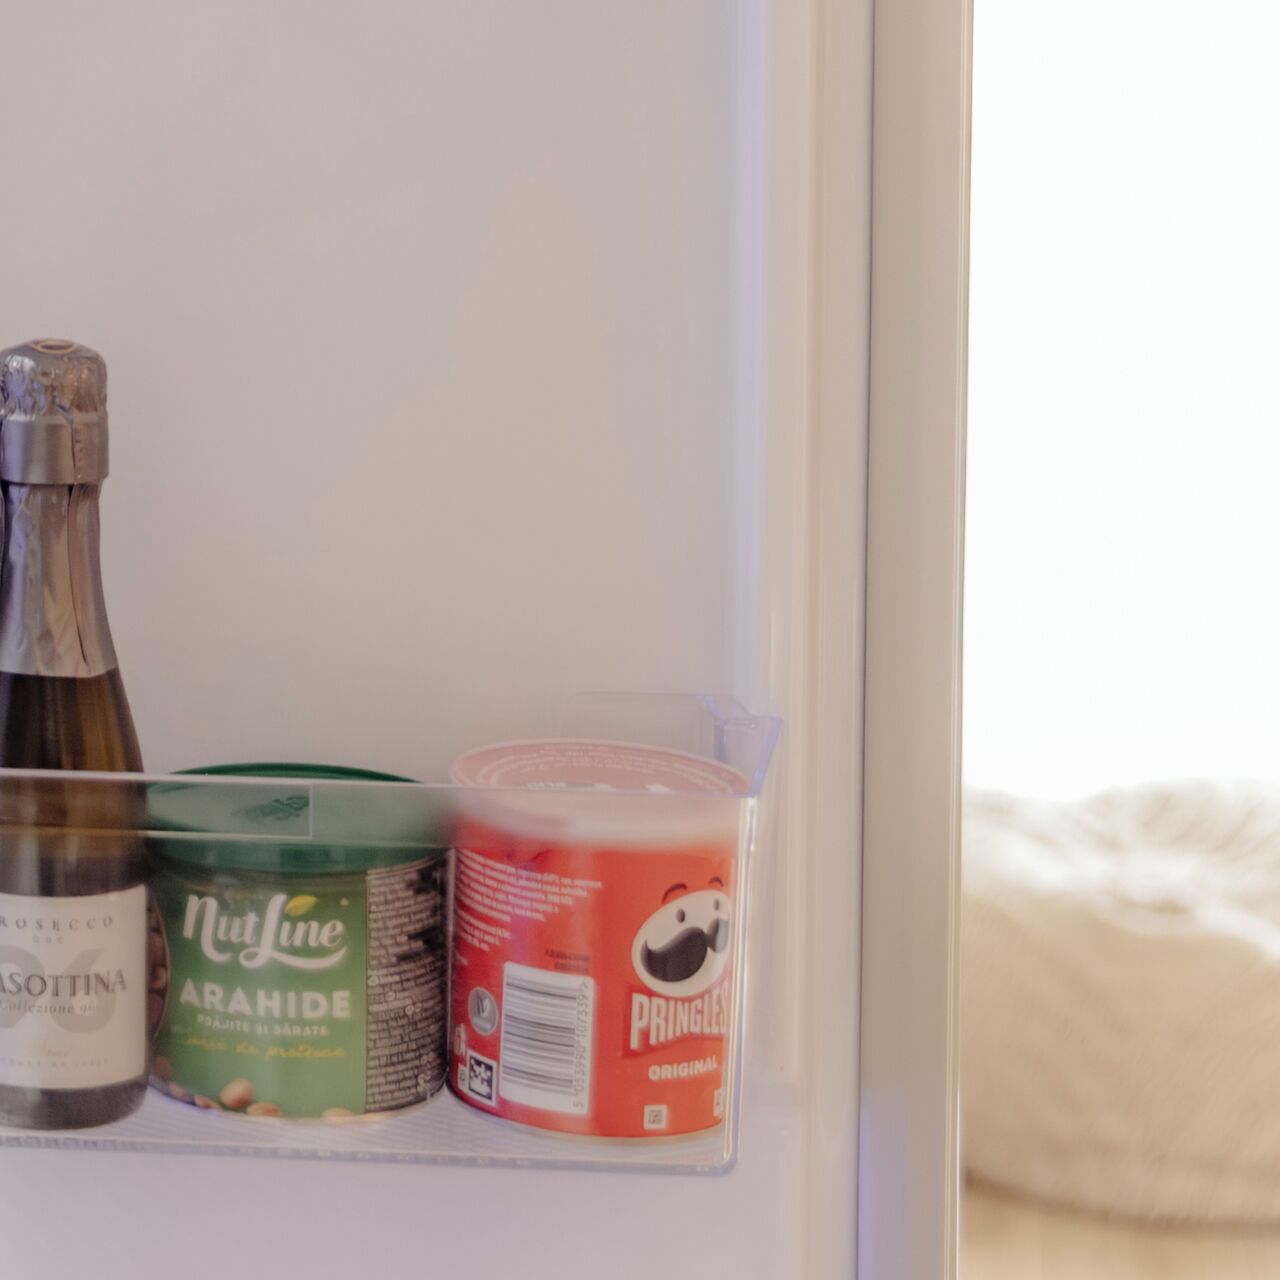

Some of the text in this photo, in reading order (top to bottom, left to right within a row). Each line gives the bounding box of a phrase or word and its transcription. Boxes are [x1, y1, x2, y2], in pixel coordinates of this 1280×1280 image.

[183, 893, 348, 969] NutLine
[179, 977, 352, 1020] ARAHIDE
[630, 978, 728, 1051] PRINGLES
[647, 1055, 719, 1081] ORIGINAL
